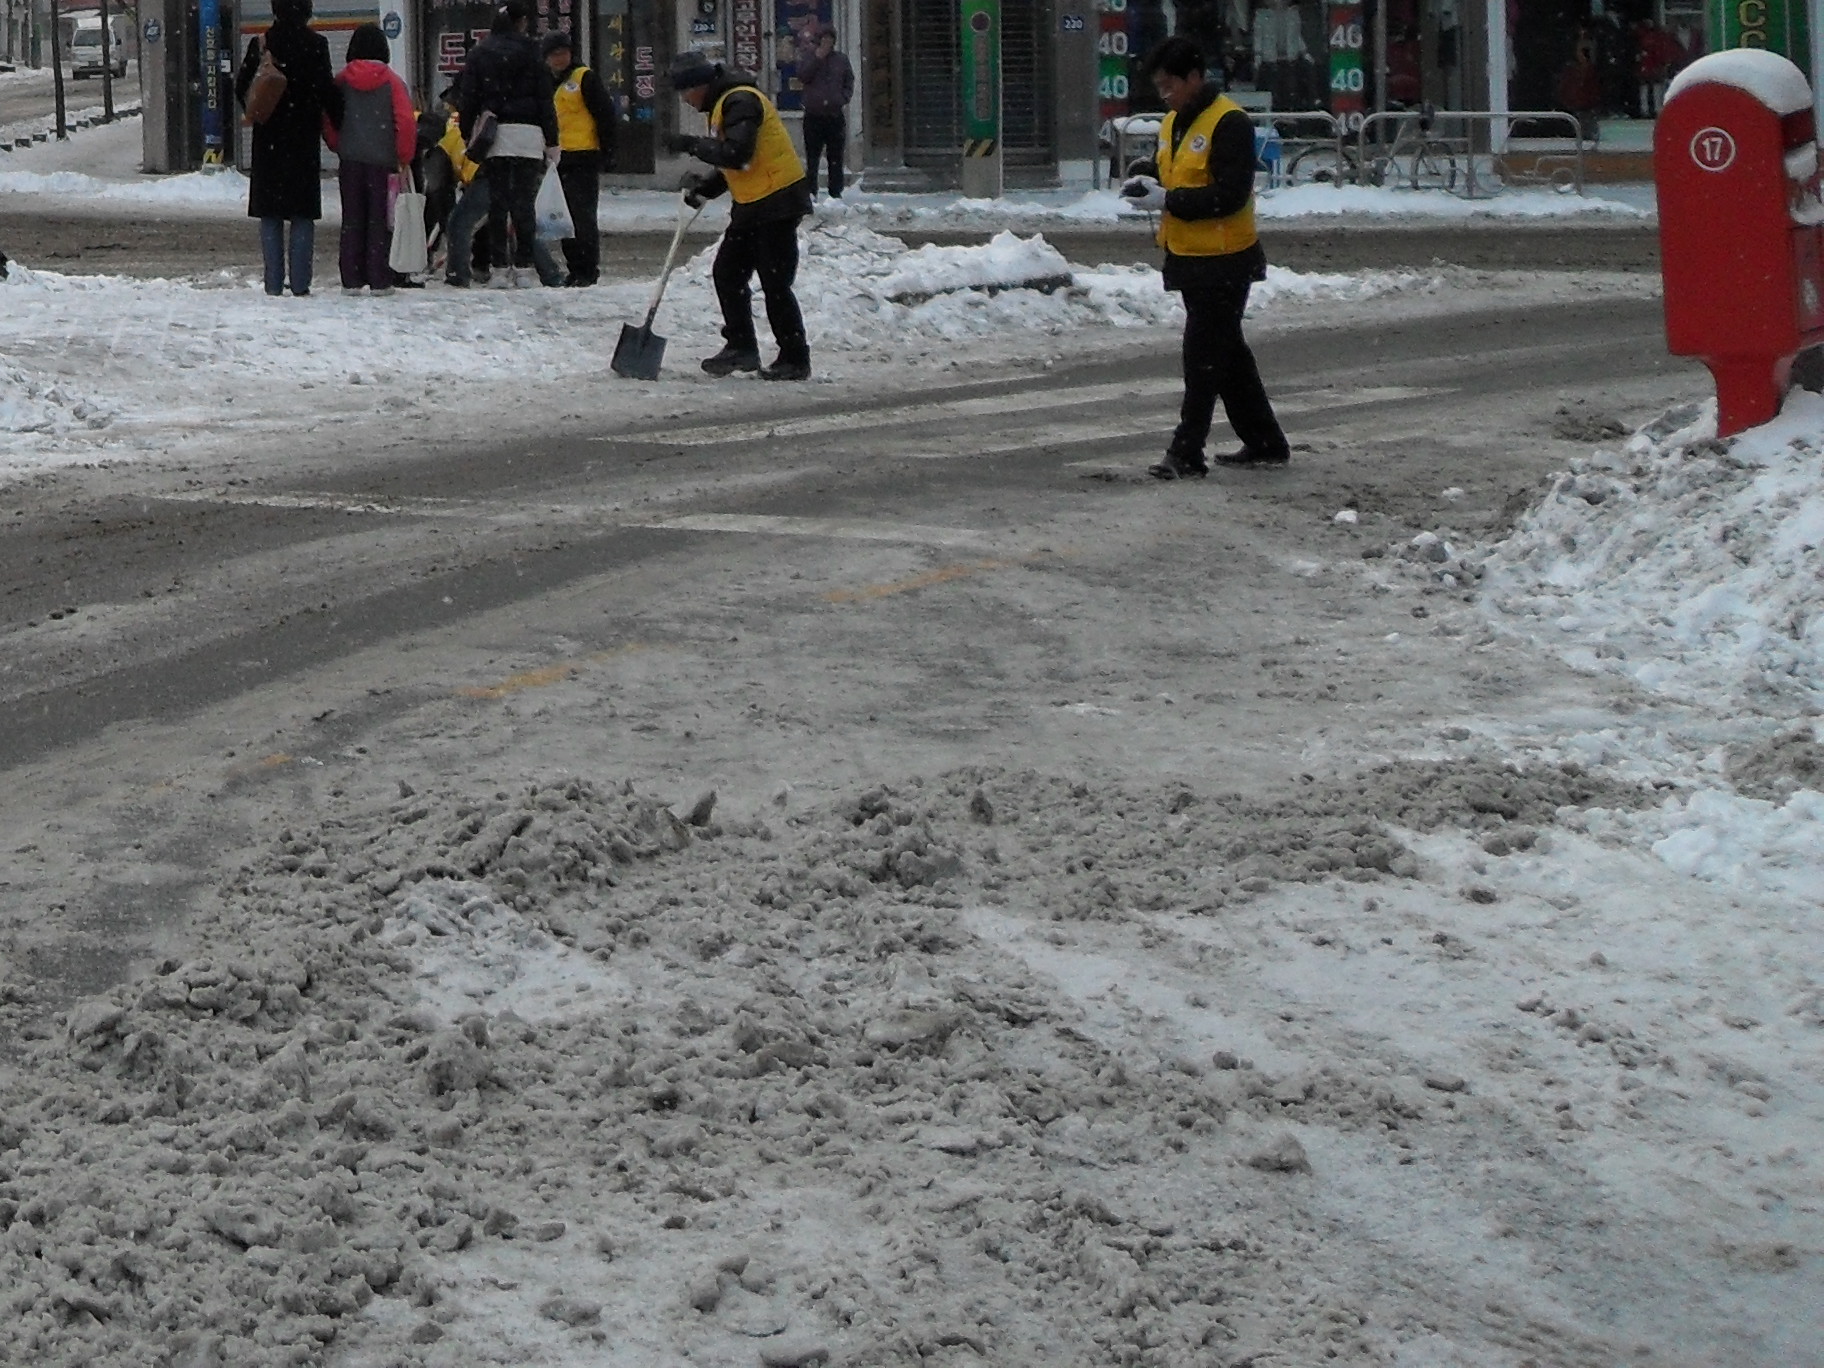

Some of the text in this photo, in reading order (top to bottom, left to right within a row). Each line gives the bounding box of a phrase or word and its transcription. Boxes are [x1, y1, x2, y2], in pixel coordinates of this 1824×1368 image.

[1064, 19, 1083, 30] 220
[1098, 30, 1128, 55] 40
[1099, 75, 1129, 99] 40
[1331, 68, 1364, 92] 40
[1701, 136, 1724, 162] 17
